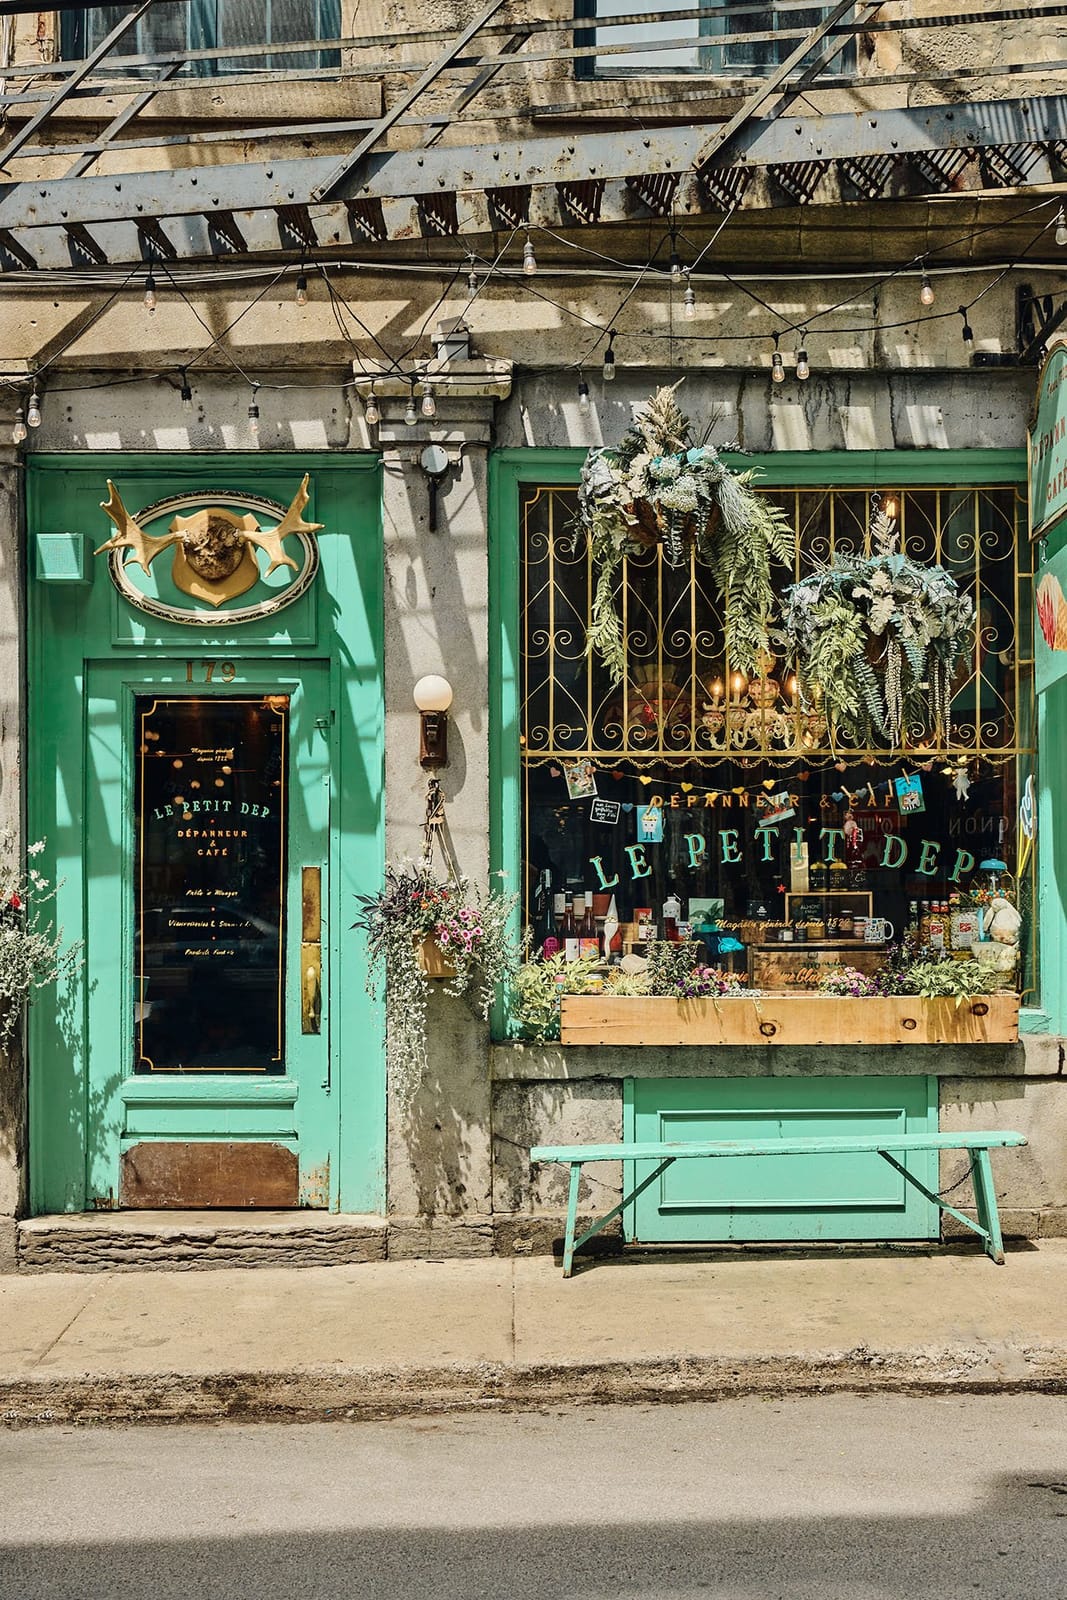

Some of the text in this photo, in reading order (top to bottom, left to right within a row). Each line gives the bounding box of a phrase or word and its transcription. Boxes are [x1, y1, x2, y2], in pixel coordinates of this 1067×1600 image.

[186, 662, 236, 683] 179
[820, 795, 831, 807] &
[849, 794, 893, 807] CAF
[154, 800, 270, 820] LE PETIT DEP
[177, 828, 248, 838] DÉPANNEUR
[197, 848, 229, 856] CAFÉ
[589, 826, 976, 891] LE PETIT DEP
